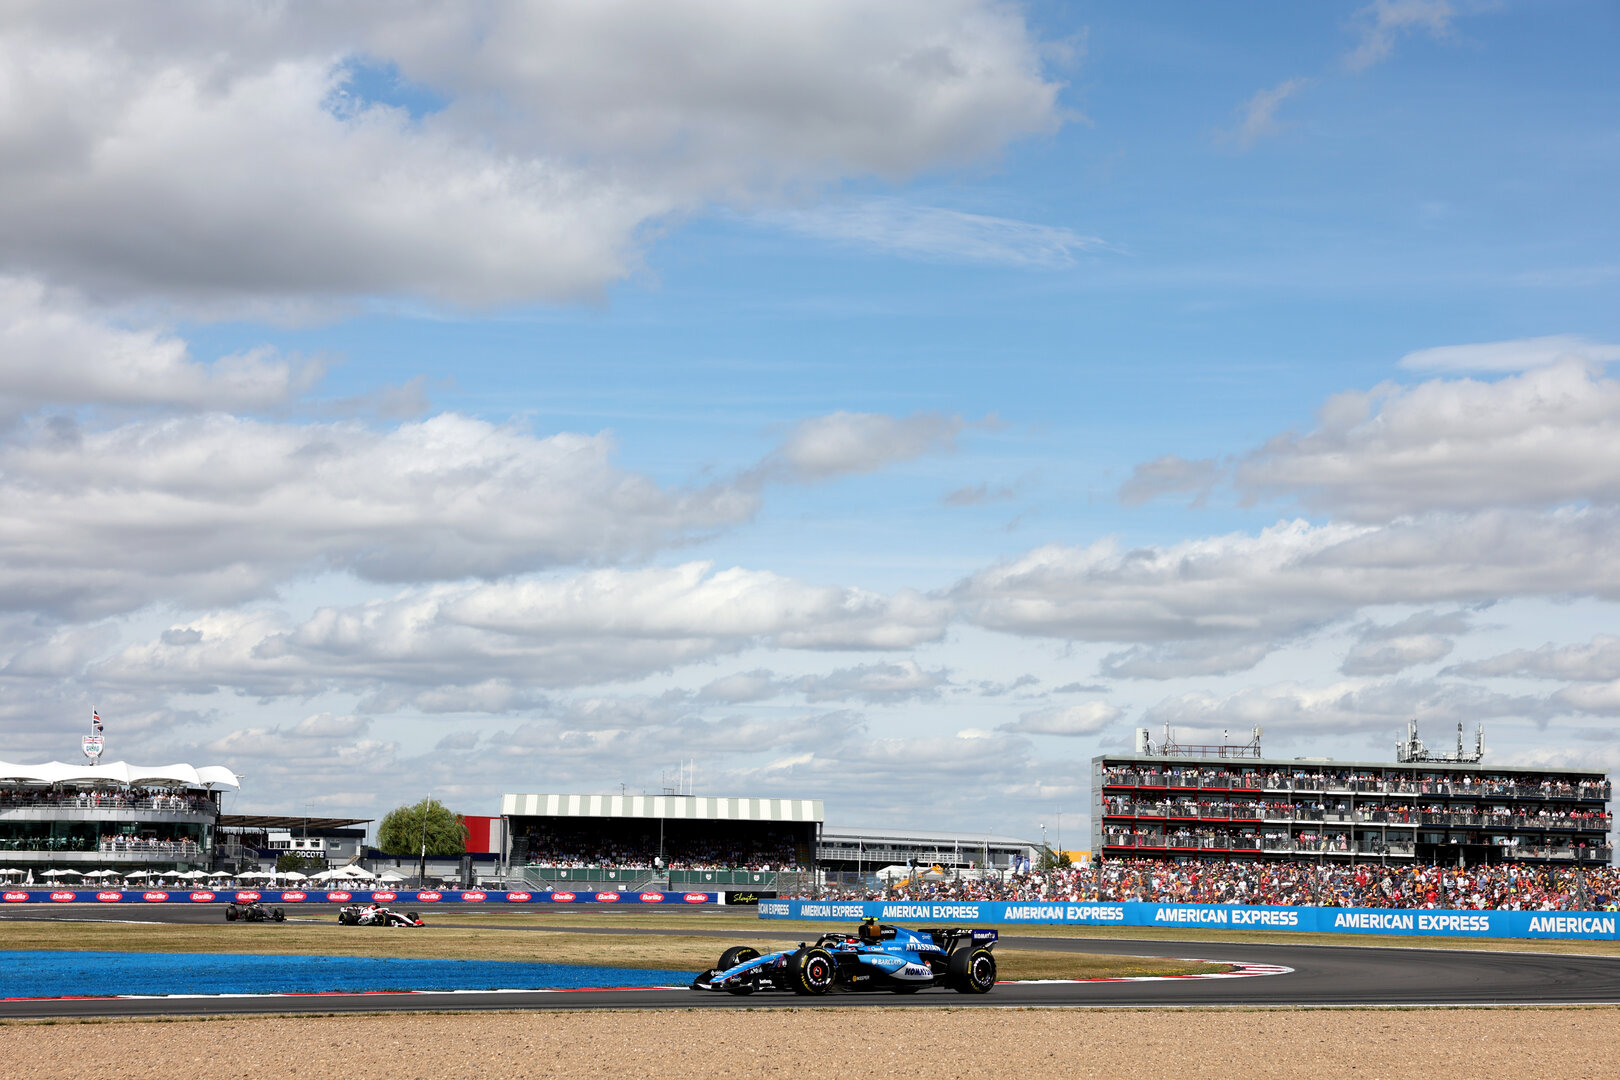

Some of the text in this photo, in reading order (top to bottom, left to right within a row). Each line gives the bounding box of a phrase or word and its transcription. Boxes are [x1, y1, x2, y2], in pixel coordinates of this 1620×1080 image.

[769, 904, 790, 916] EXPRESS
[801, 905, 864, 917] AMERICAN EXPRESS
[882, 906, 979, 919] AMERICAN EXPRESS
[1004, 906, 1124, 921] AMERICAN EXPRESS
[1155, 908, 1299, 926] AMERICAN EXPRESS
[1334, 913, 1490, 931] AMERICAN EXPRESS
[1528, 916, 1616, 934] AMERICAN
[906, 943, 941, 952] ATLASSIAN
